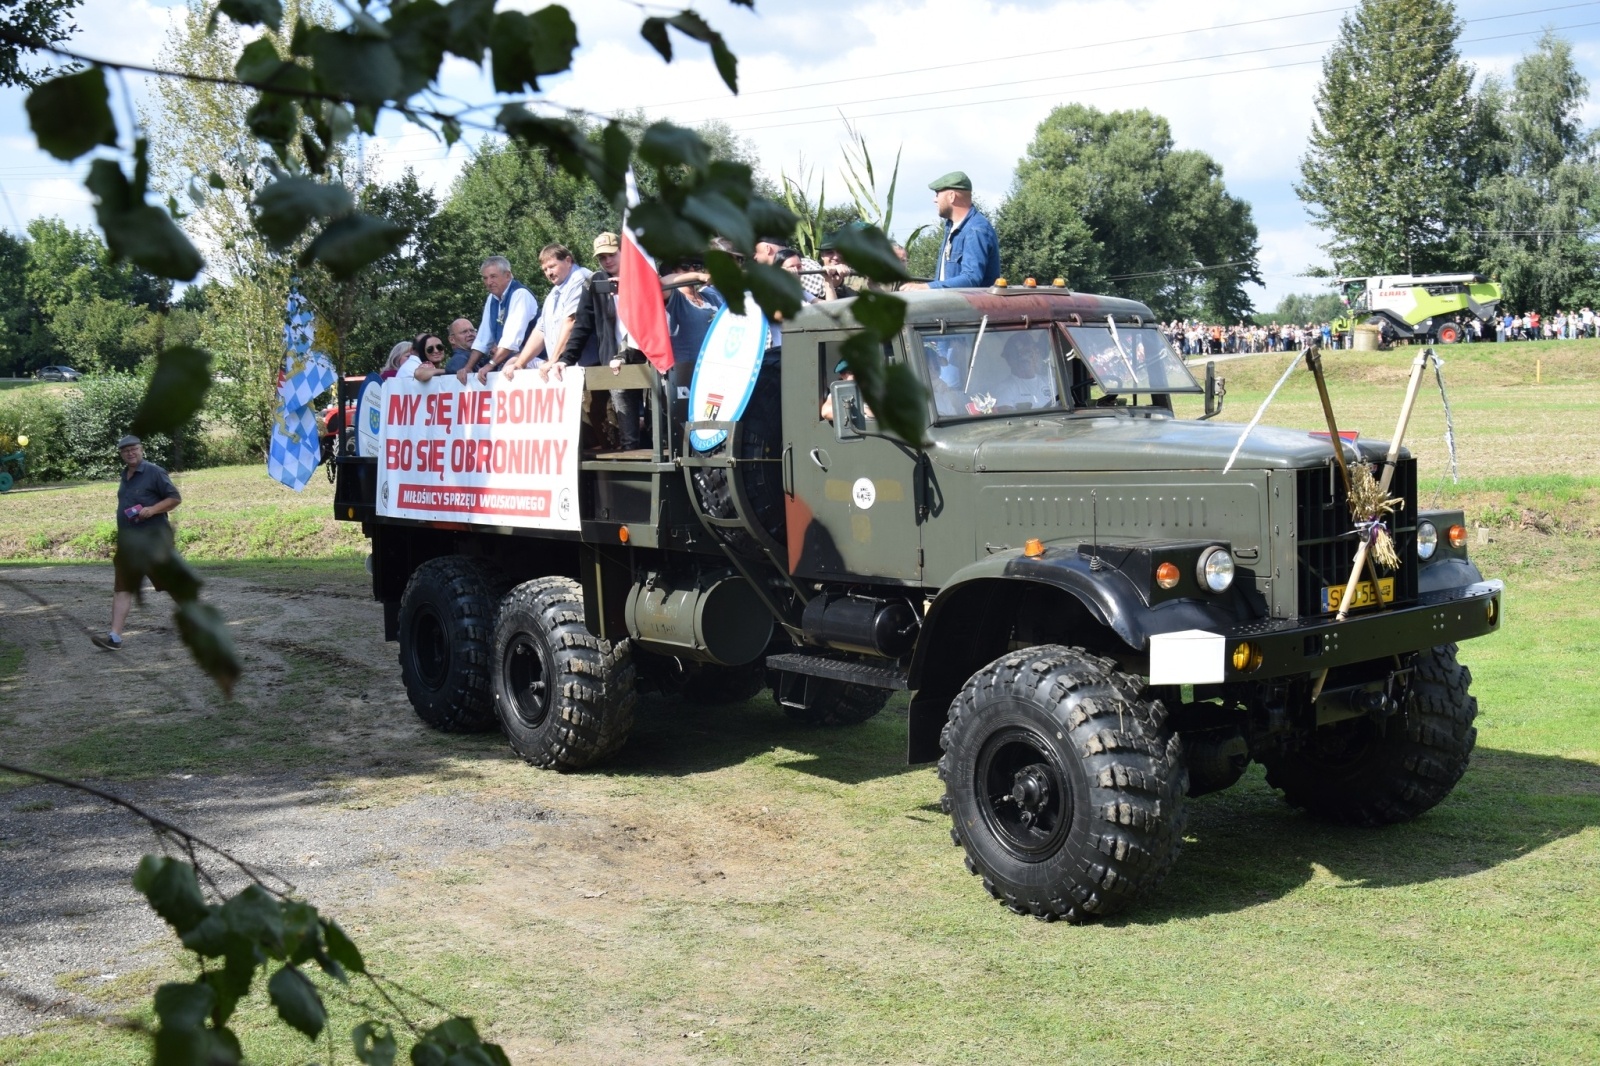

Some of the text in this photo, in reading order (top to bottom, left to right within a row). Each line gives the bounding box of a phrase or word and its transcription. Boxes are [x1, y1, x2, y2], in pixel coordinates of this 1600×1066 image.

[387, 387, 566, 434] MY SIĘ NIE BOIMY
[386, 438, 568, 482] BO SIĘ OBRONIMY
[479, 493, 546, 512] WOJSKOWEGO
